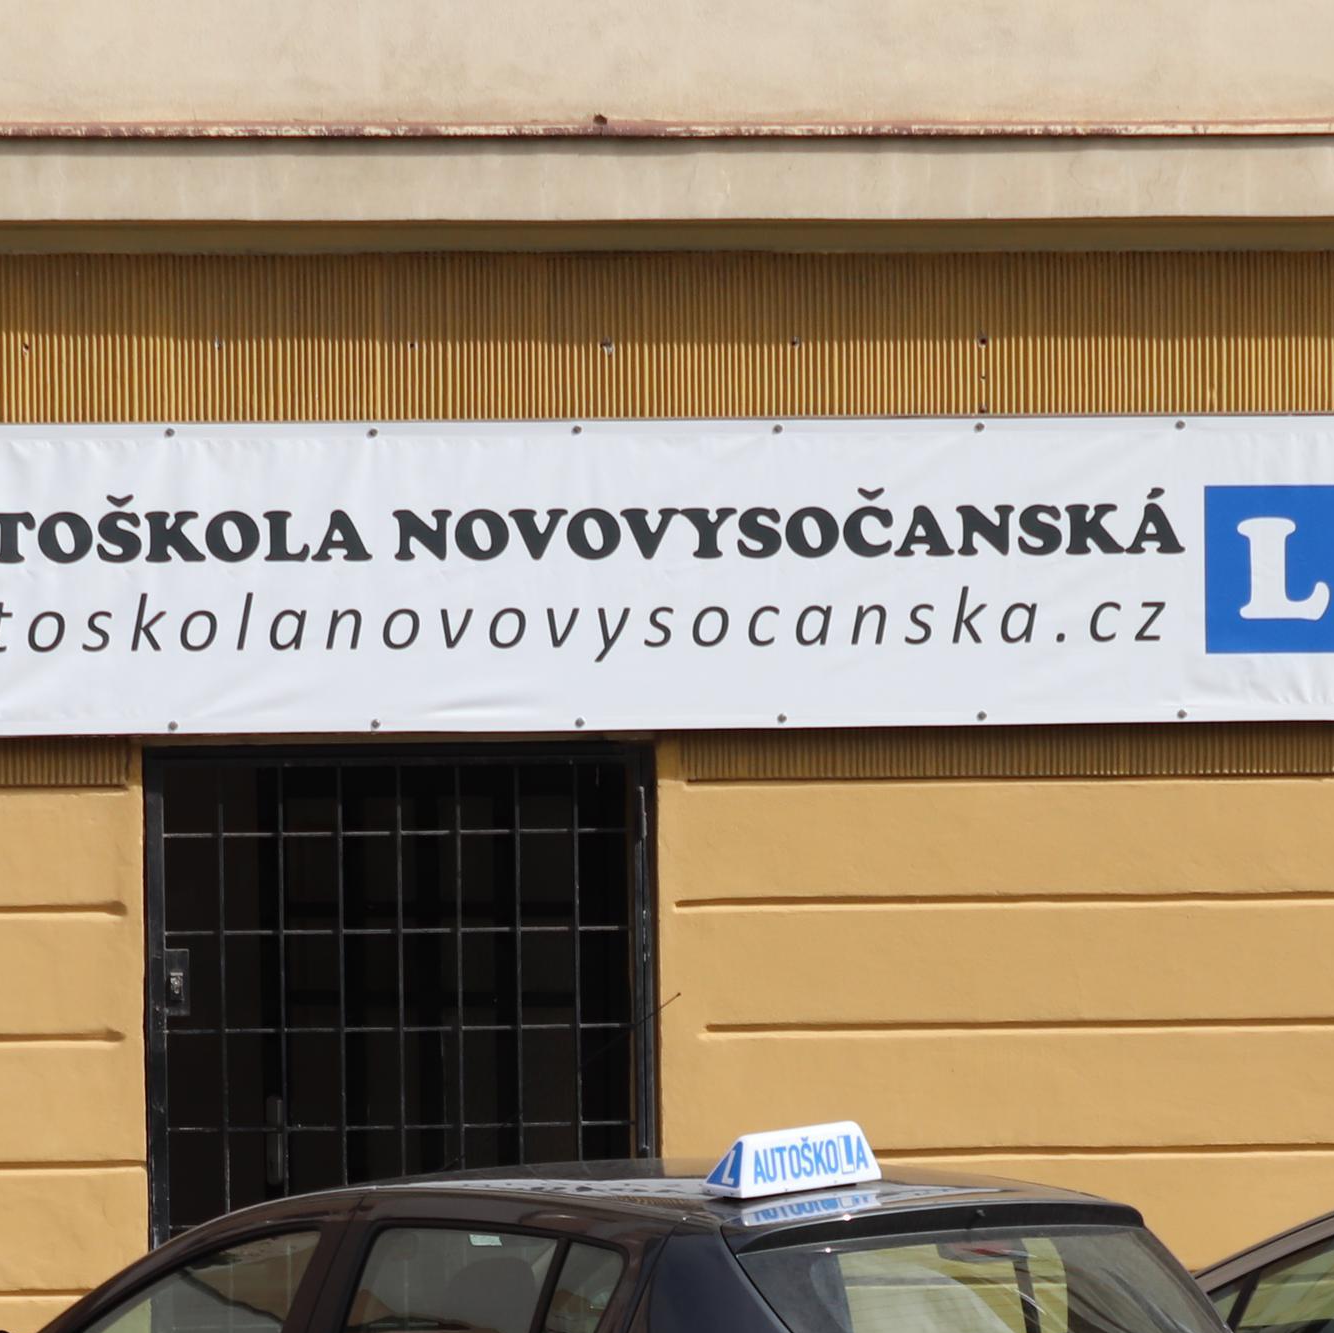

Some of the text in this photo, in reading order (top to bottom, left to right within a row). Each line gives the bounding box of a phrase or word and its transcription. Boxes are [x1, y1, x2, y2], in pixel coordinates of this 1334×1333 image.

[393, 487, 1185, 563] NOVOVYSOČANSKÁ
[1236, 517, 1330, 620] L
[753, 1135, 869, 1185] AUTOŠKOLA
